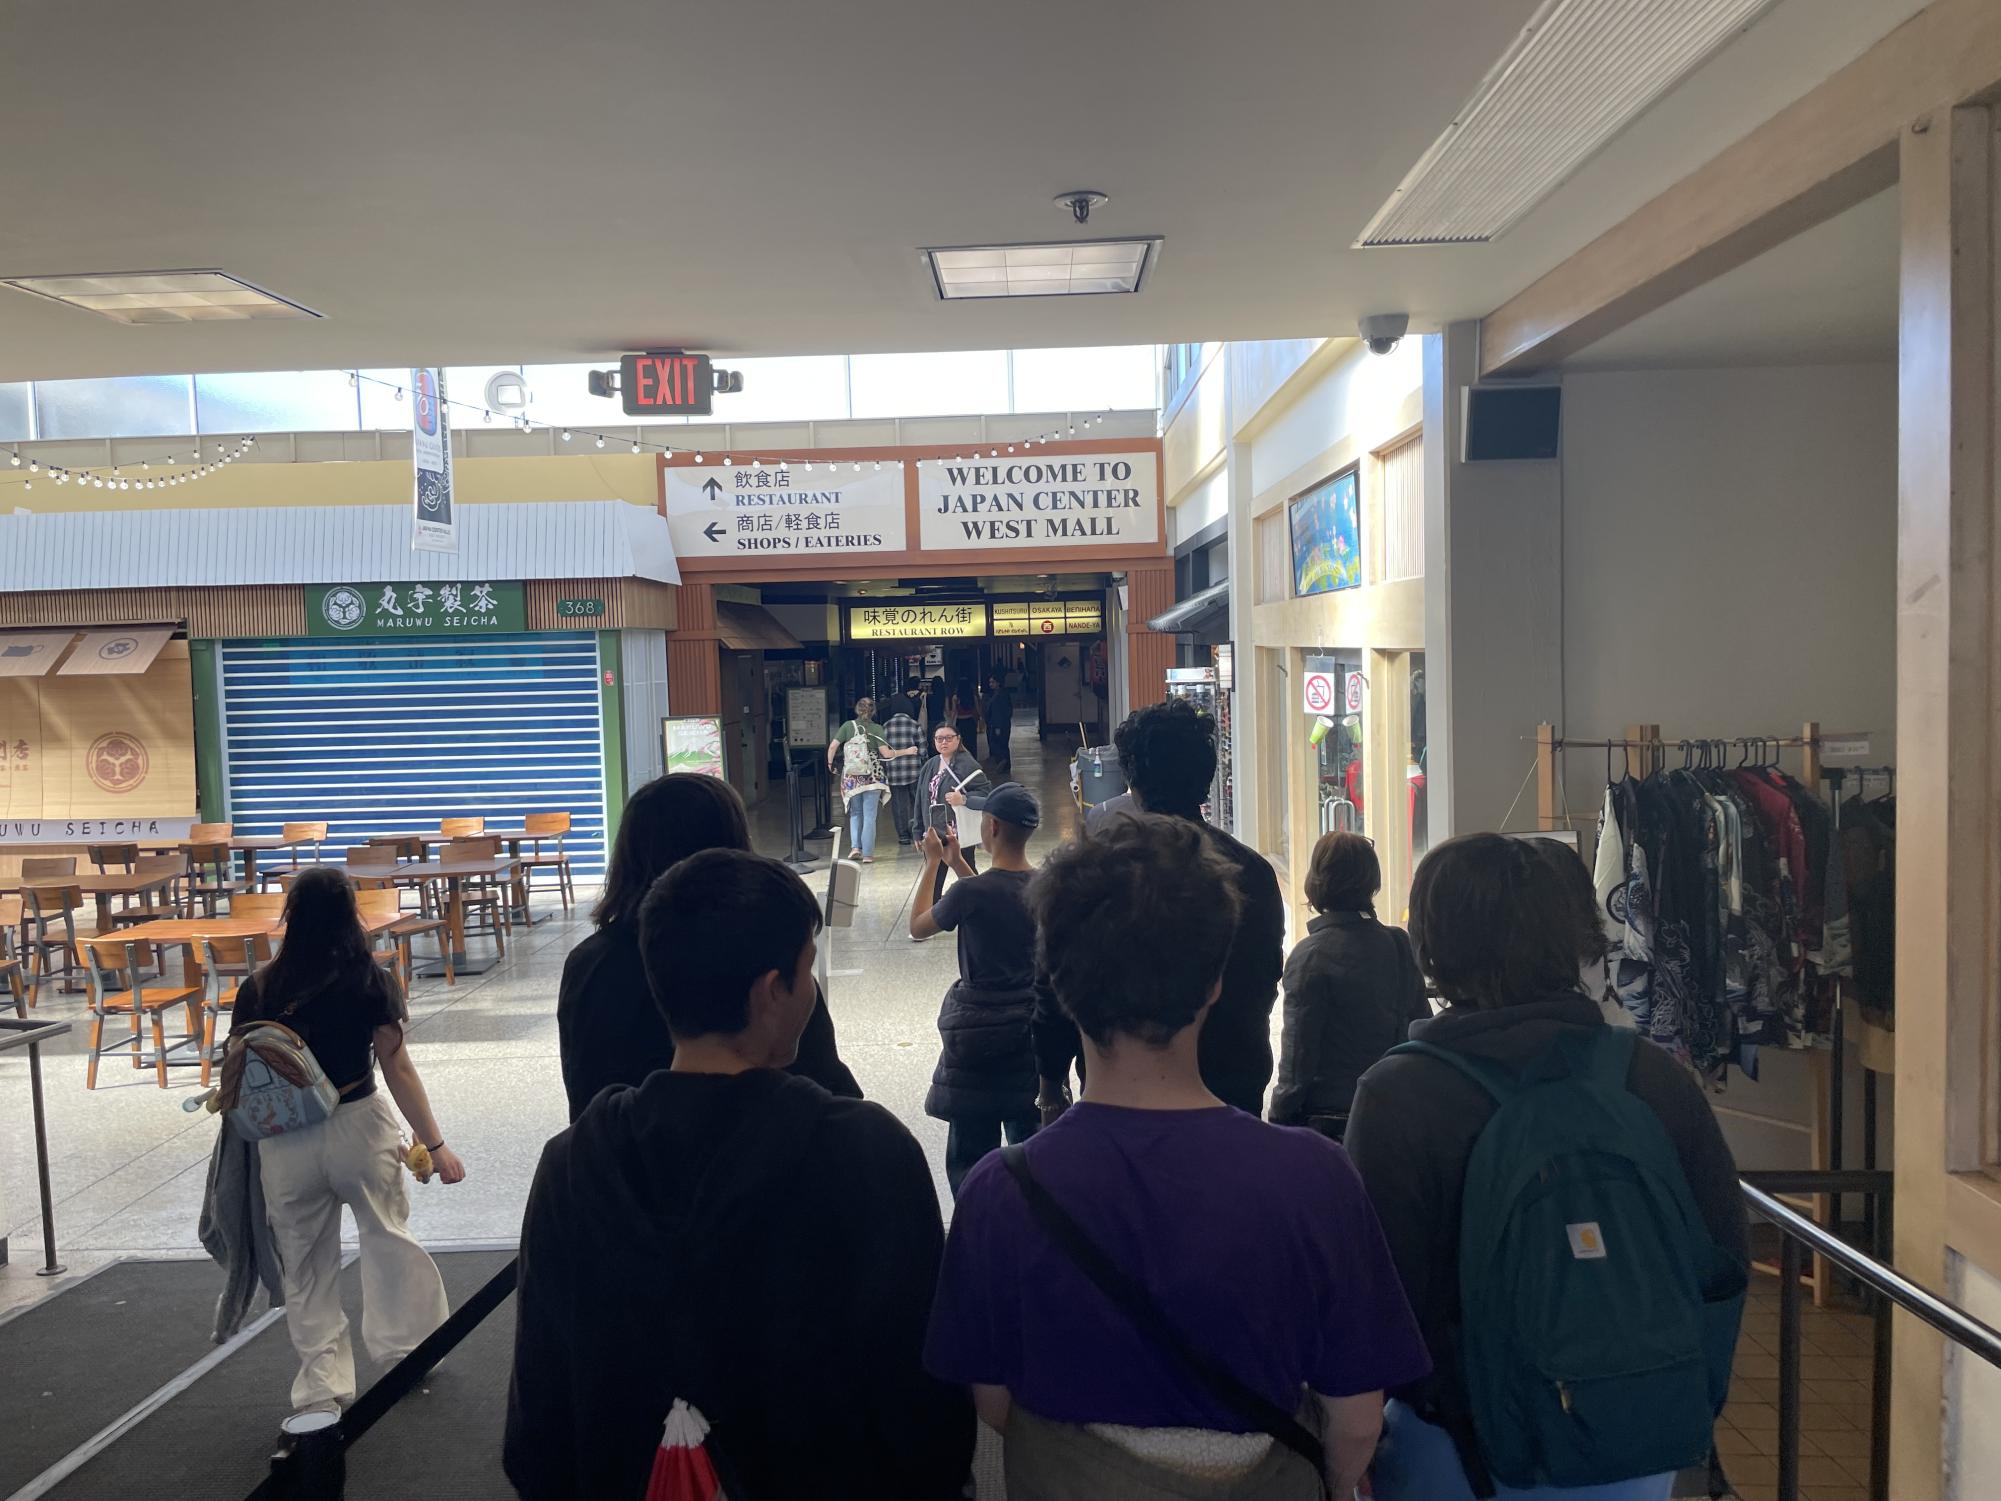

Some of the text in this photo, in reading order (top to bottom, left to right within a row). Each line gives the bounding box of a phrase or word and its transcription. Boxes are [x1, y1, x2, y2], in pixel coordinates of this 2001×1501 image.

[636, 358, 698, 405] EXIT
[734, 469, 791, 489] 飲食店
[946, 461, 1132, 487] WELCOME TO
[735, 491, 842, 507] RESTAURANT
[937, 488, 1141, 515] JAPAN CENTER
[736, 511, 841, 533] 商店/軽食店
[960, 516, 1121, 541] WEST MALL
[737, 536, 791, 551] SHOPS
[804, 533, 882, 549] EATERIES
[565, 601, 595, 614] 368
[863, 607, 973, 626] 味覚のれん街
[377, 615, 498, 628] MARUWU SEICHA
[872, 627, 966, 637] RESTAURANT ROW
[66, 820, 159, 836] SEICHA
